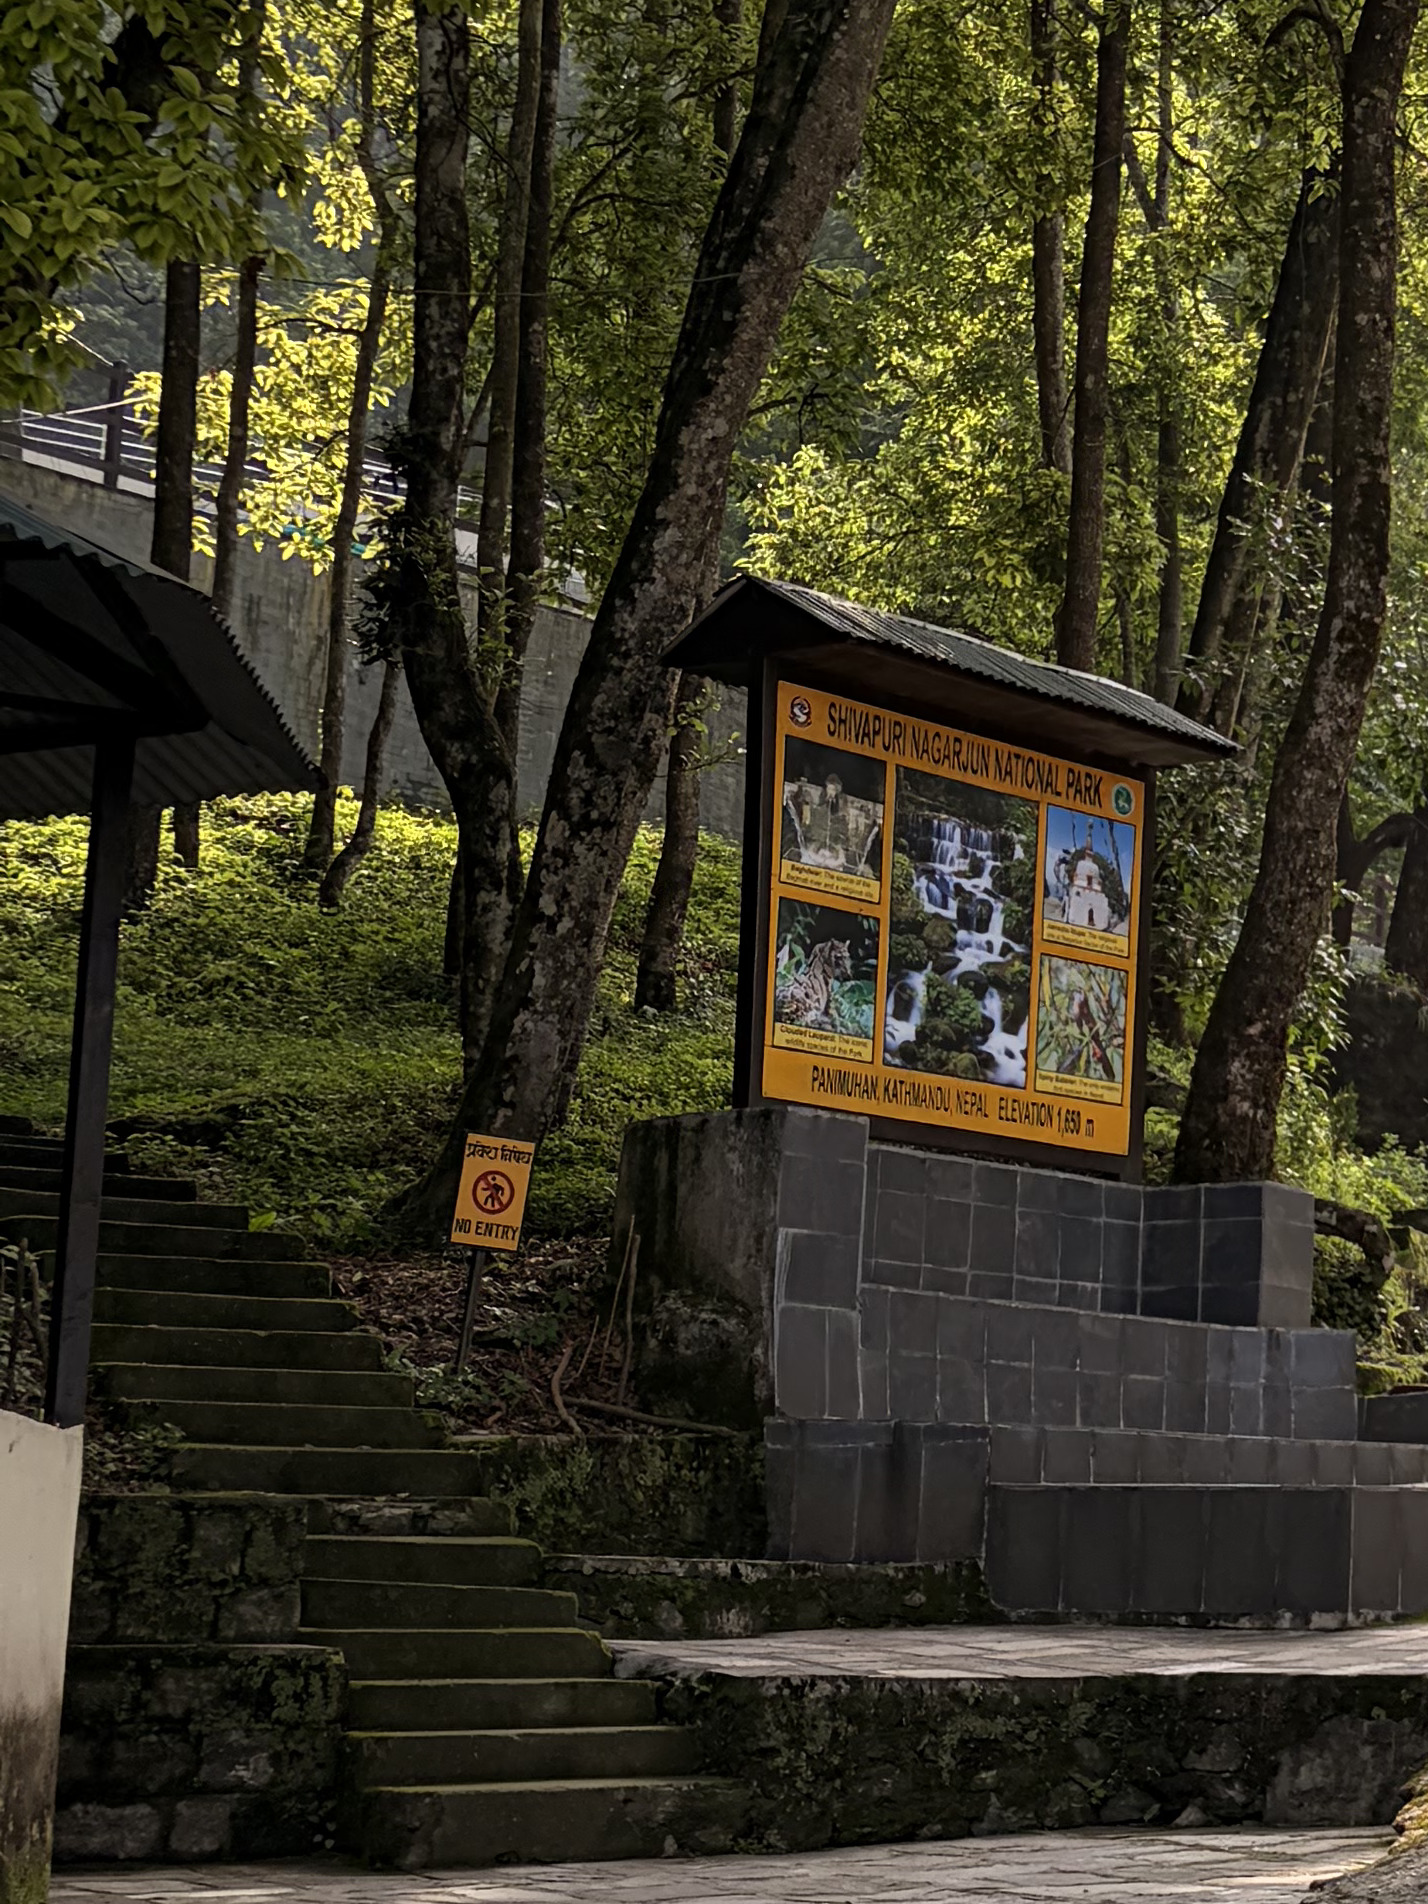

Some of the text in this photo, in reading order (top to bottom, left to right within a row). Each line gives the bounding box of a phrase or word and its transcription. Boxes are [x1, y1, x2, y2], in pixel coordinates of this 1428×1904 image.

[827, 701, 1103, 808] SHIVAPURI NAGARJUN NATIONAL PARK
[811, 1065, 880, 1107] PANIMUHAN,
[883, 1076, 953, 1117] KATHMANDU,
[956, 1091, 989, 1119] NEPAL
[998, 1097, 1053, 1128] ELEVATION
[1085, 1118, 1095, 1138] m
[454, 1218, 519, 1241] NO ENTRY
